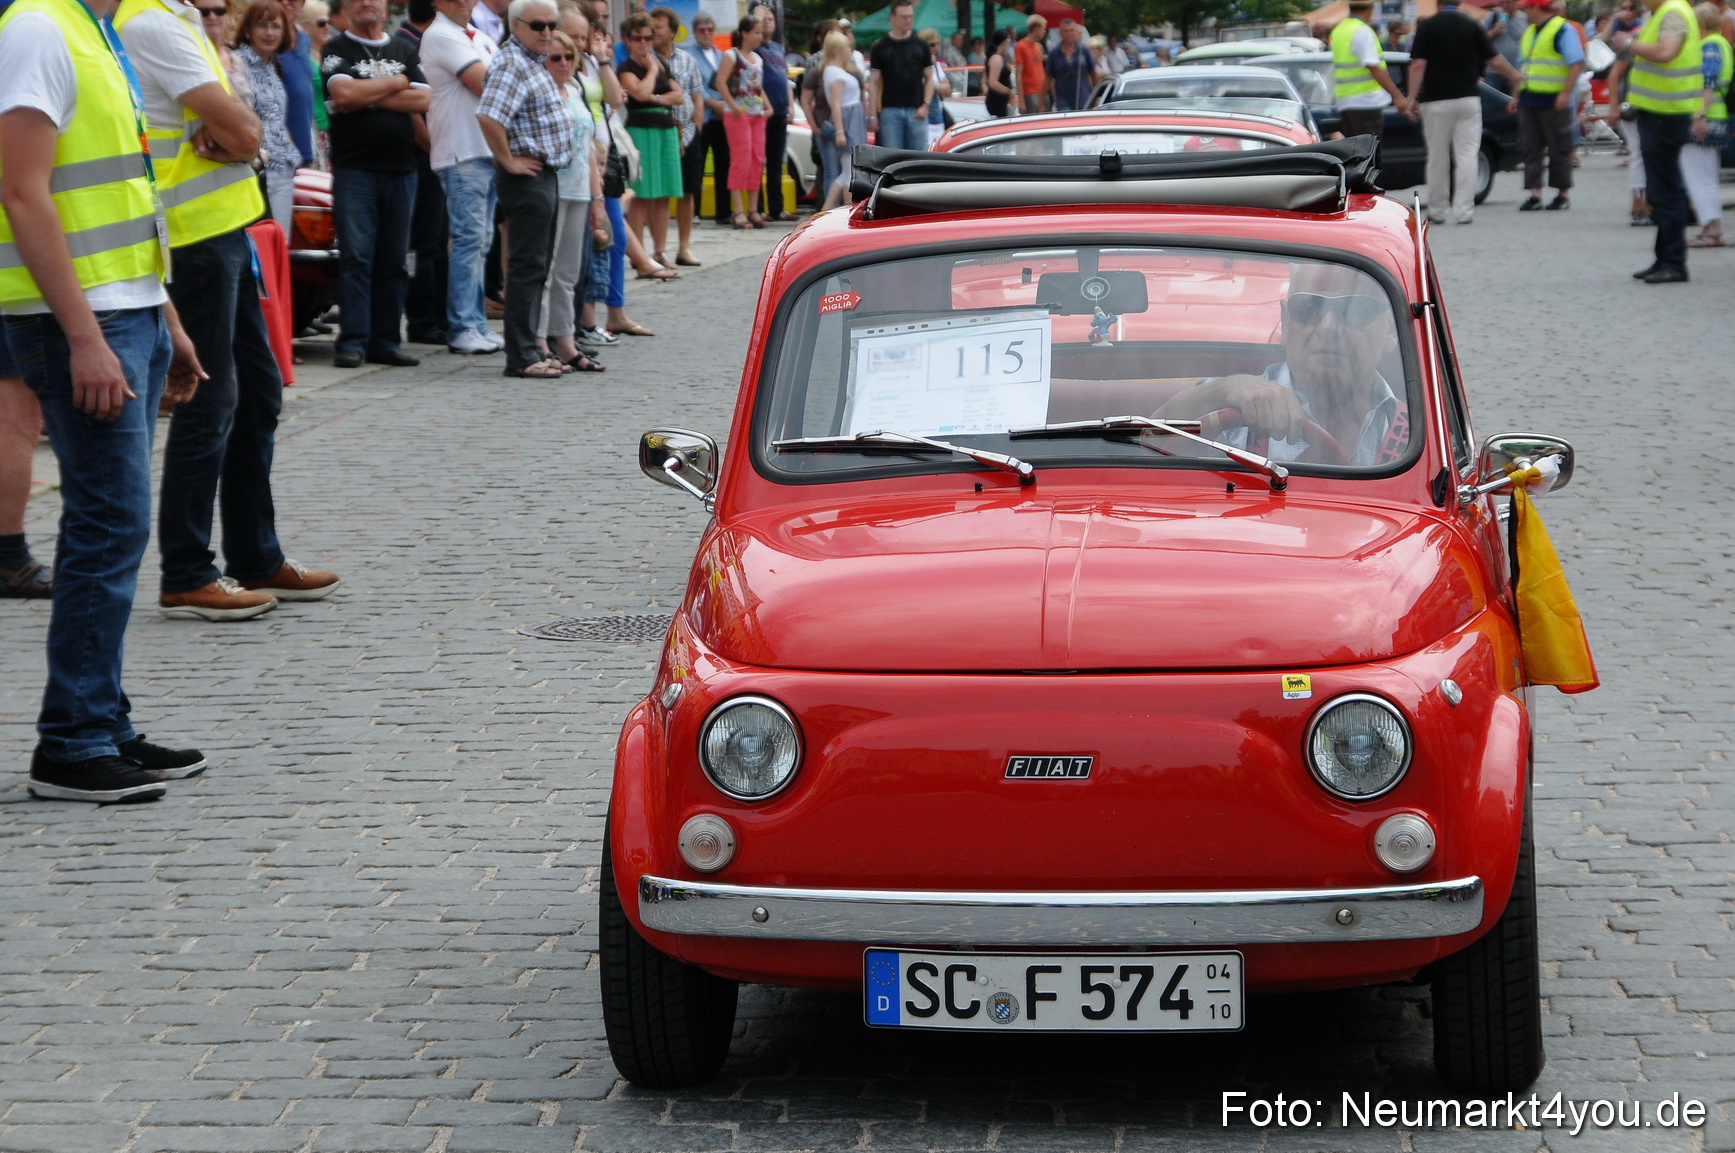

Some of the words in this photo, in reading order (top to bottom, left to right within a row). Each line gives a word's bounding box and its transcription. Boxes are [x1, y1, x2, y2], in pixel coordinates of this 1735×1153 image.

[821, 300, 852, 312] MIGLIA
[823, 293, 850, 304] 1000
[955, 340, 1025, 379] 115
[1011, 759, 1088, 776] FIAT
[1206, 963, 1231, 980] 04
[904, 961, 981, 1019] SC
[1024, 964, 1063, 1020] F
[1080, 963, 1195, 1021] 574
[877, 995, 890, 1011] D
[1209, 1002, 1231, 1020] 10
